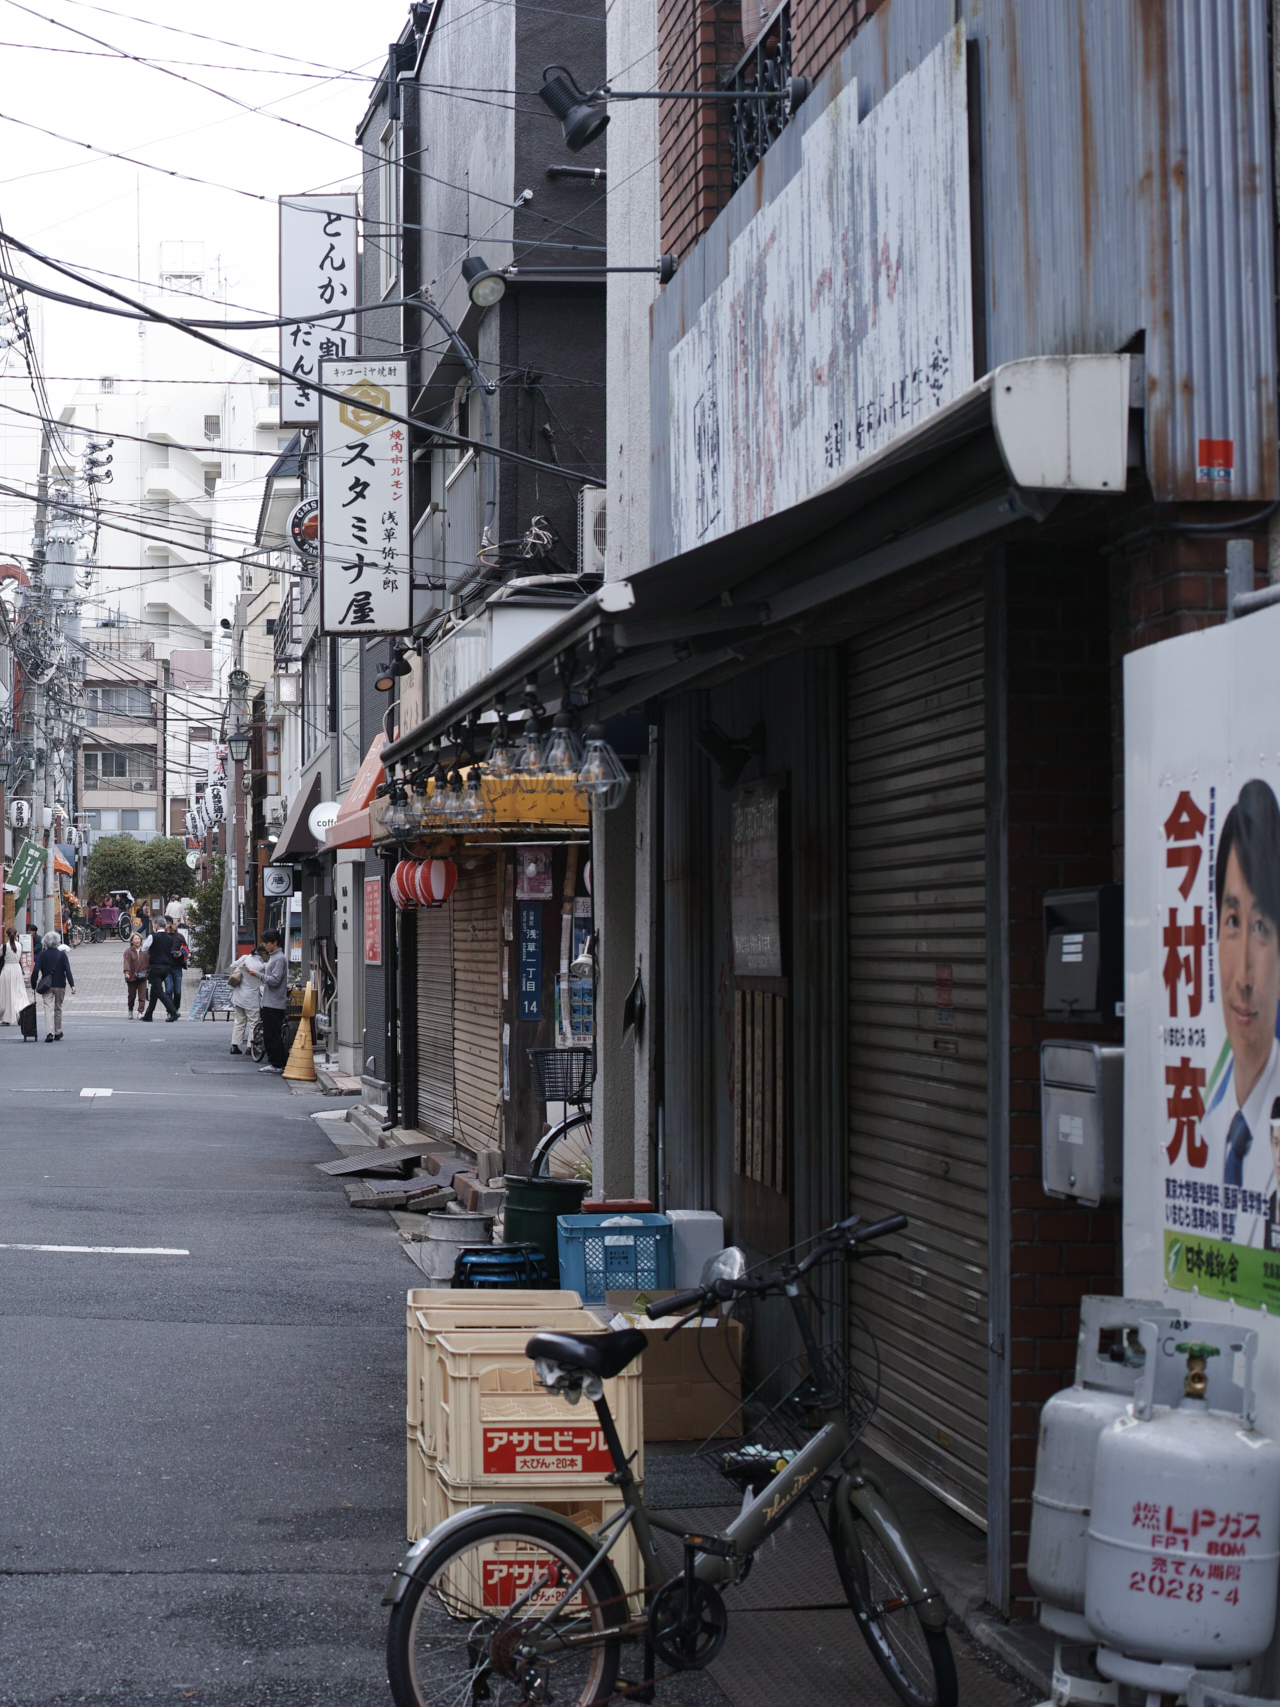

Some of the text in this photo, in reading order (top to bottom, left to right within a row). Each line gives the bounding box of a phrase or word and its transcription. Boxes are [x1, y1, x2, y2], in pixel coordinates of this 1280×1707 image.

[333, 366, 397, 377] キッコーミヤ焼酎
[389, 430, 404, 502] 焼肉ホルモン
[338, 442, 378, 625] スタミナ屋
[381, 511, 399, 593] 浅草弥太郎
[523, 929, 538, 1014] 浅草一丁目 14
[1163, 791, 1208, 1169] 今村 充
[486, 1431, 609, 1453] アサヒビール
[519, 1457, 578, 1470] 大びん・20本
[1152, 1535, 1190, 1553] FP1
